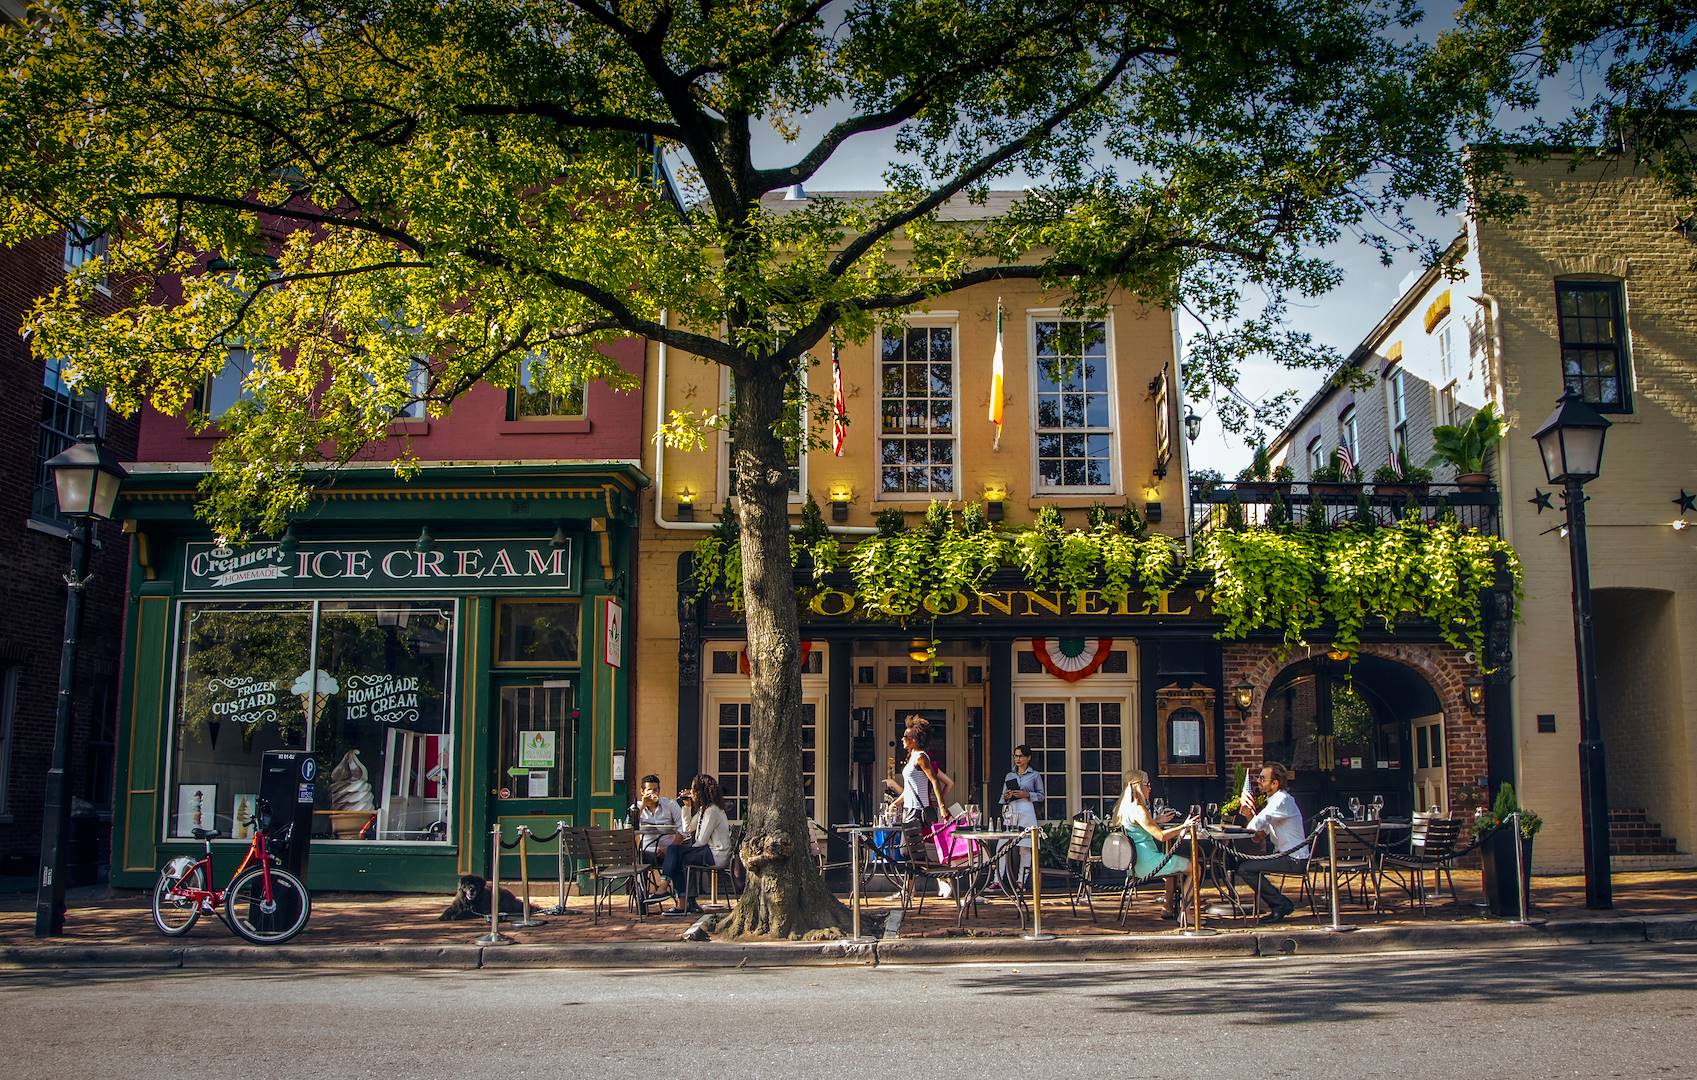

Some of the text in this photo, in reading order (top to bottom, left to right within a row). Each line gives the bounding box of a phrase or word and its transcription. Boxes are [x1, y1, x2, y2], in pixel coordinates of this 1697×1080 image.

[191, 545, 285, 577] Creamery
[294, 548, 566, 580] ICE CREAM
[224, 569, 276, 583] HOMEMADE
[809, 590, 1225, 616] OCONNELL'
[237, 681, 277, 698] FROZEN
[347, 676, 419, 704] HOMEMADE
[211, 693, 276, 715] CUSTARD
[347, 693, 418, 720] ICE CREAM
